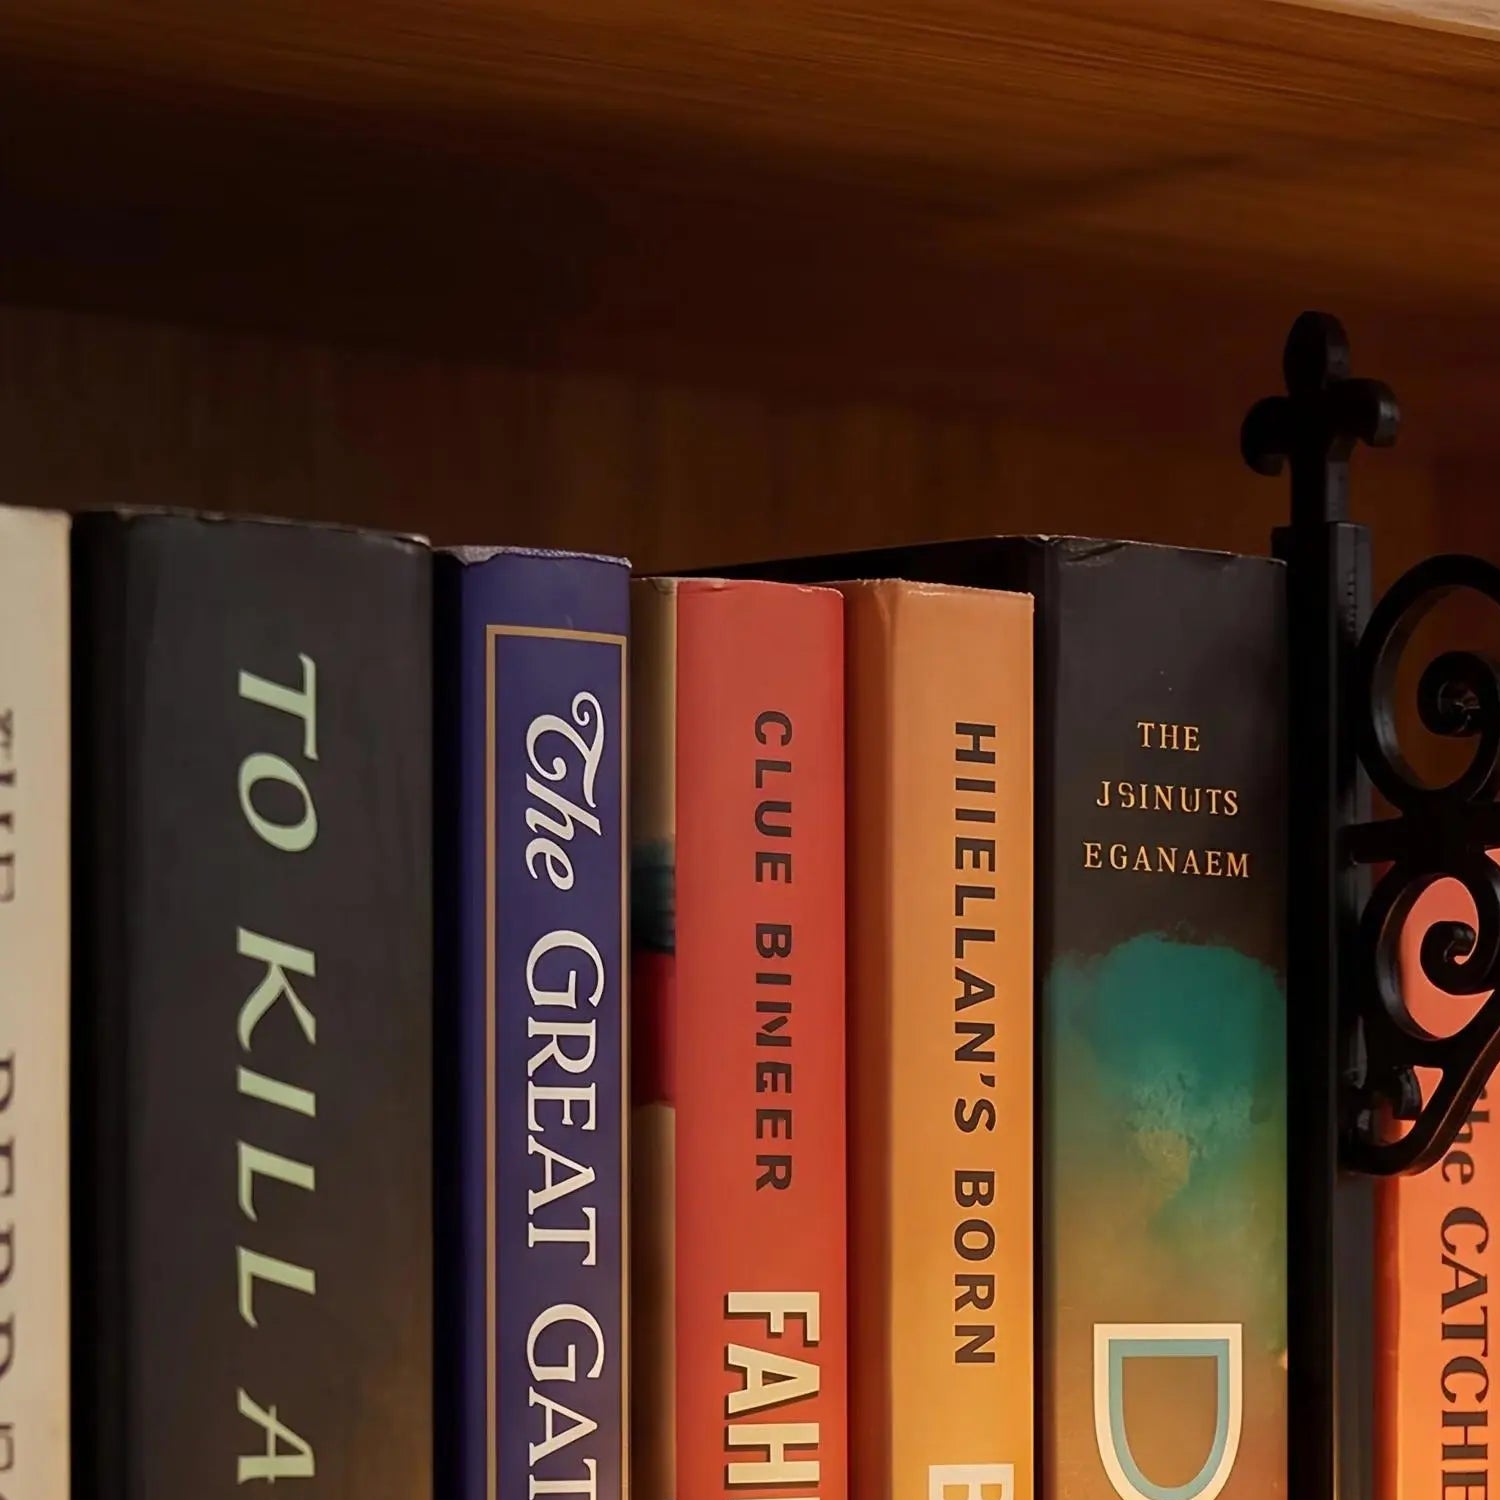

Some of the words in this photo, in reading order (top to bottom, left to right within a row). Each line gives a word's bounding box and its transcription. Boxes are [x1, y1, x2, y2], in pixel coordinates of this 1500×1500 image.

[239, 654, 317, 851] TO
[526, 692, 604, 889] The
[755, 711, 792, 883] CLUE
[1138, 722, 1199, 751] THE
[1084, 843, 1248, 877] EGANAEM
[238, 928, 315, 1326] KILL
[527, 930, 604, 1265] GREAT
[954, 1170, 995, 1363] BORN
[238, 1390, 314, 1482] A
